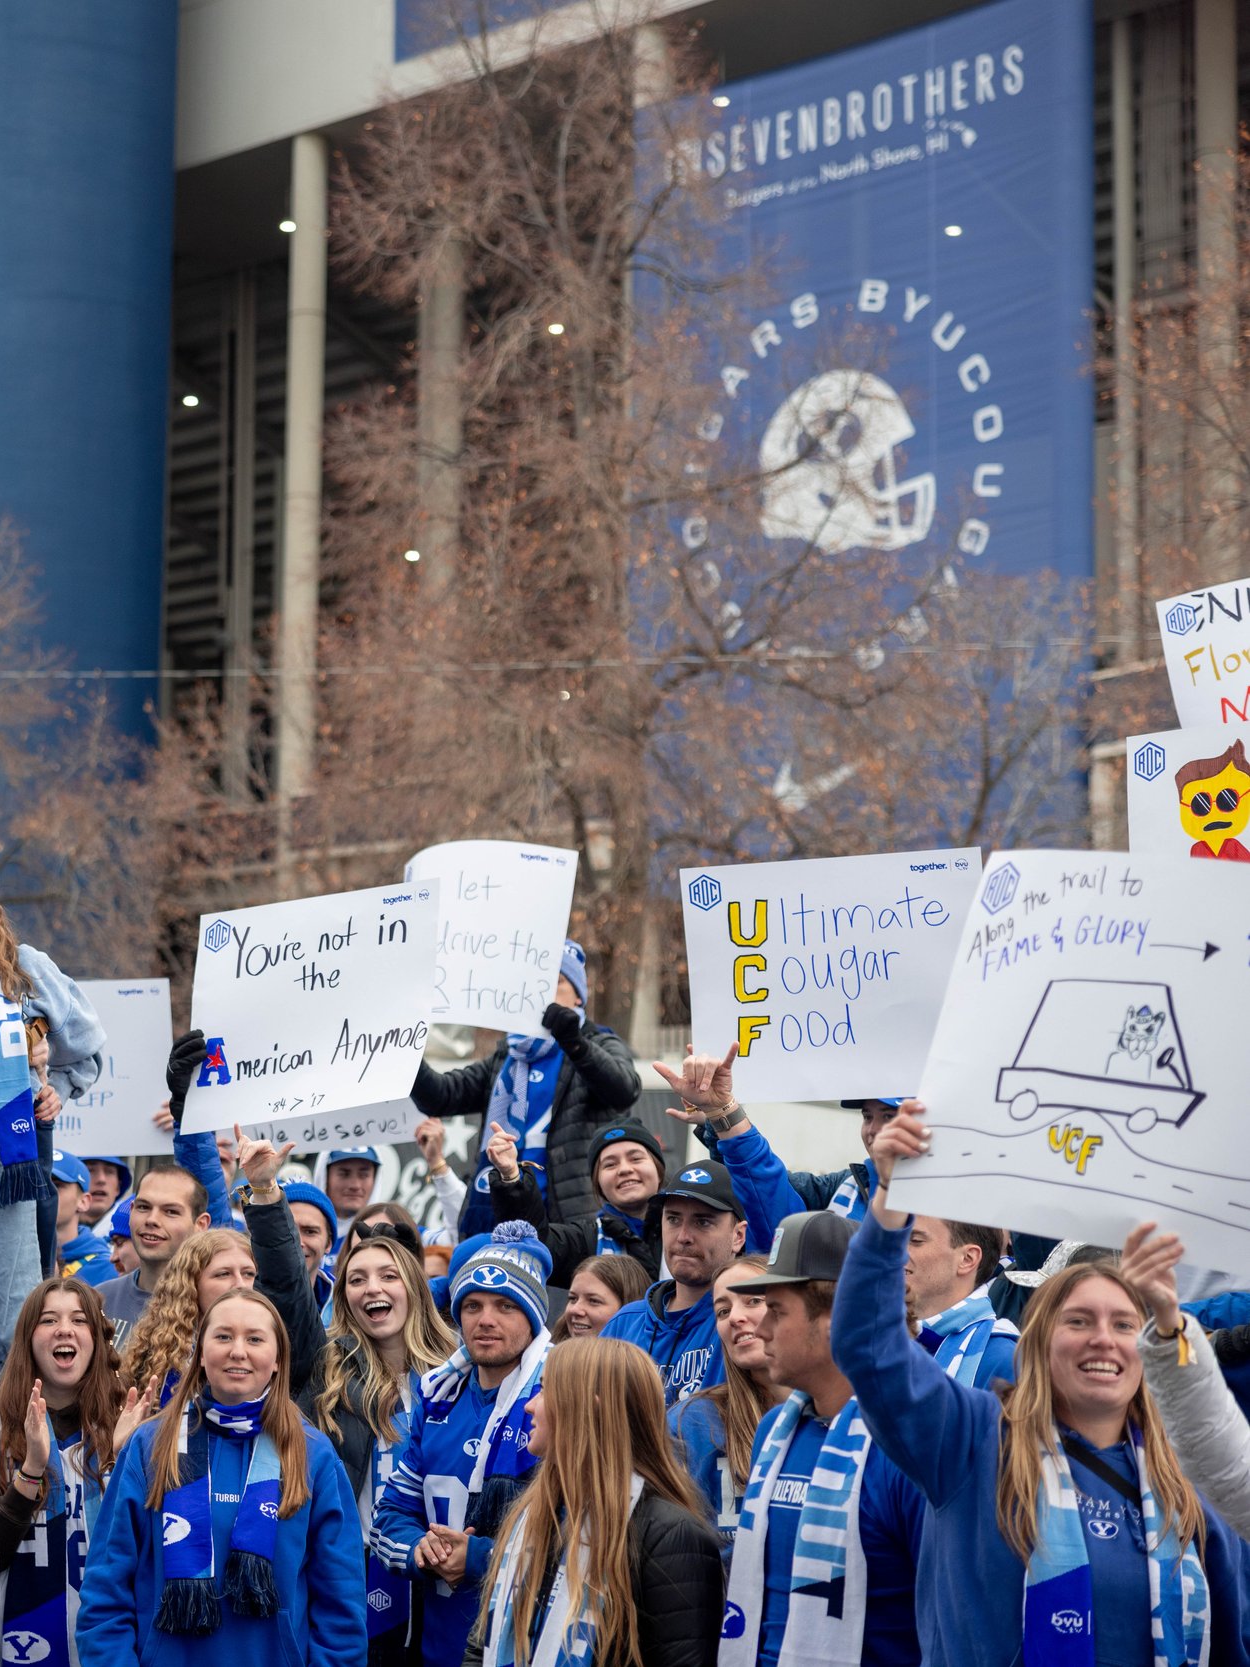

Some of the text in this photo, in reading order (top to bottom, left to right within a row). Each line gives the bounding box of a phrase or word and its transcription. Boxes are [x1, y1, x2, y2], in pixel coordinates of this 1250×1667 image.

[458, 870, 502, 901] let
[910, 861, 948, 873] together.
[382, 893, 413, 906] together.
[727, 886, 950, 948] Ultimate
[967, 866, 1144, 963] Along the trail to
[231, 914, 408, 979] You're not in
[508, 930, 550, 971] the
[981, 931, 1042, 982] FAME
[1075, 915, 1152, 956] GLORY
[294, 962, 341, 992] the
[461, 969, 551, 1014] truck?
[733, 945, 900, 1004] Cougar
[196, 1036, 313, 1088] American
[330, 1018, 428, 1083] Anymore
[737, 1003, 856, 1057] Food
[1048, 1123, 1103, 1175] UCF
